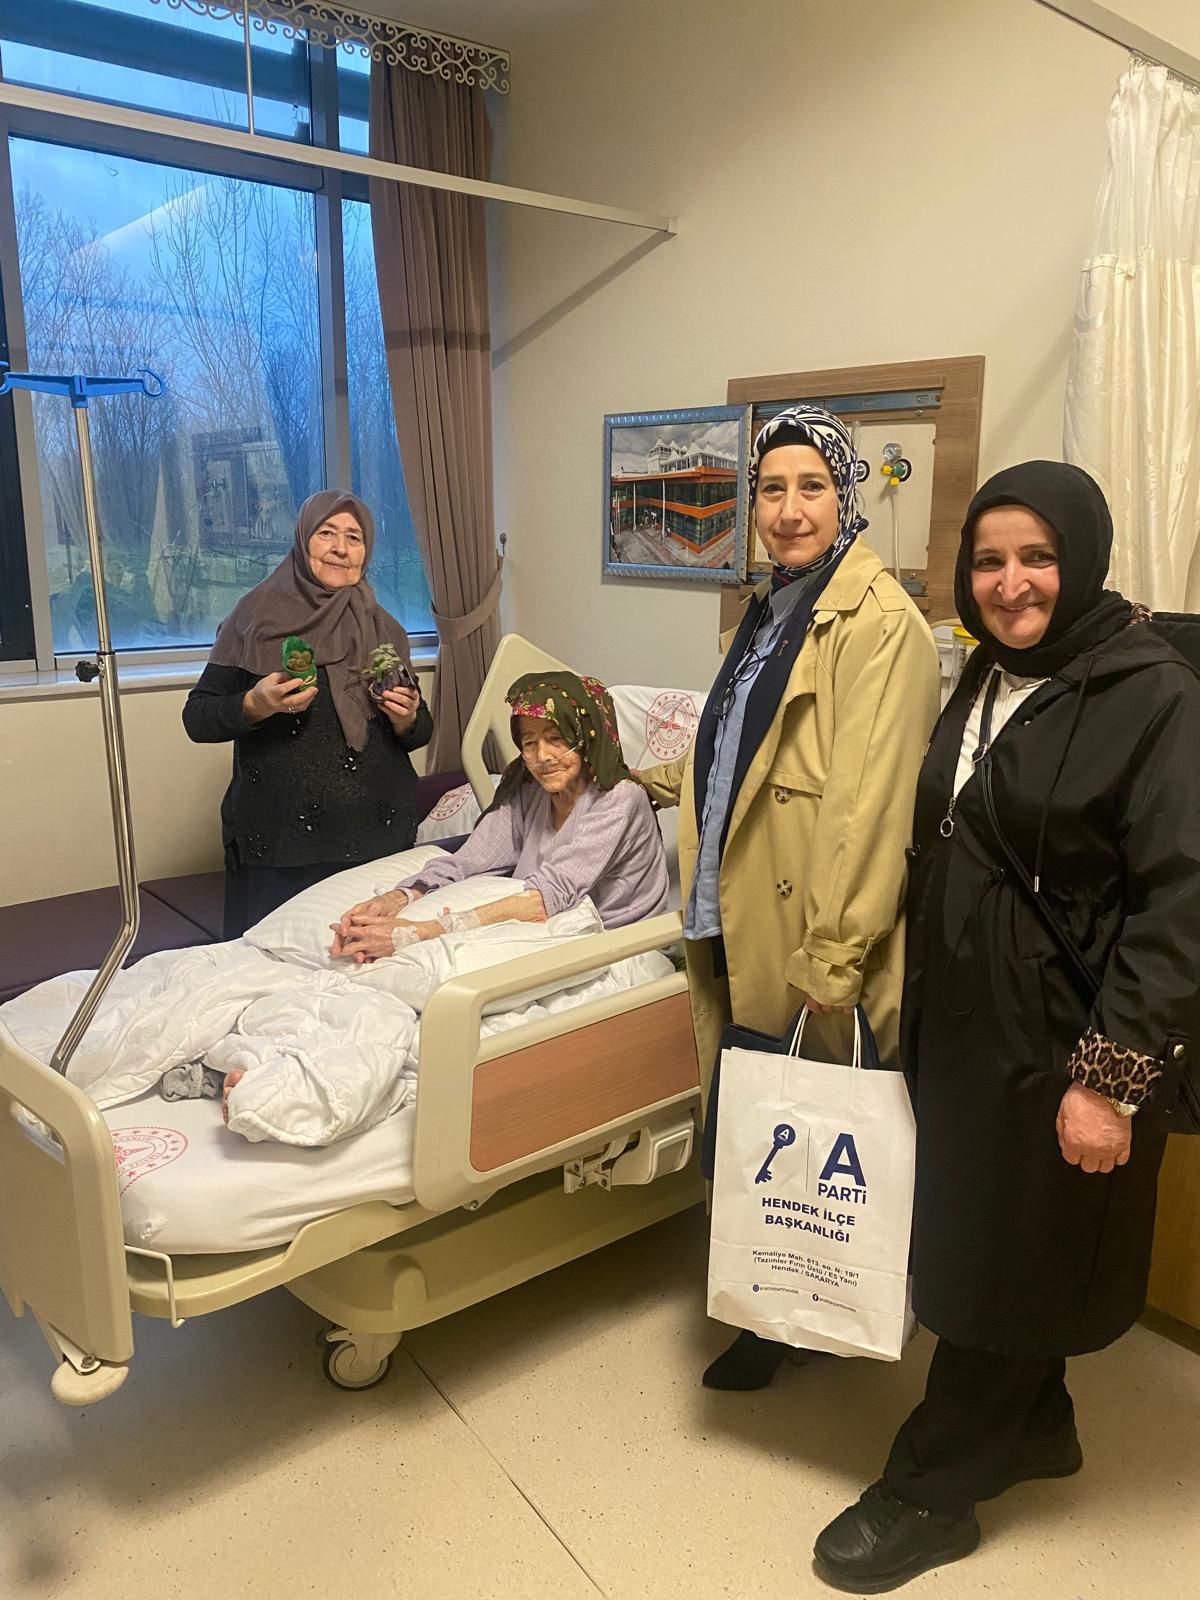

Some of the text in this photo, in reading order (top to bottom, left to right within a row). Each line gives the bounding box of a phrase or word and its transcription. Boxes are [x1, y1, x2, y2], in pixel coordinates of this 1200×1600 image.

[819, 1132, 867, 1187] A
[762, 1197, 856, 1226] HENDEK İLÇE
[765, 1214, 850, 1243] BAŞKANLIĞI
[752, 1250, 786, 1258] Kemaliye
[788, 1253, 806, 1262] Mah.
[845, 1270, 859, 1279] 19/1
[771, 1264, 799, 1273] Hendek
[804, 1271, 840, 1288] SAKARYA
